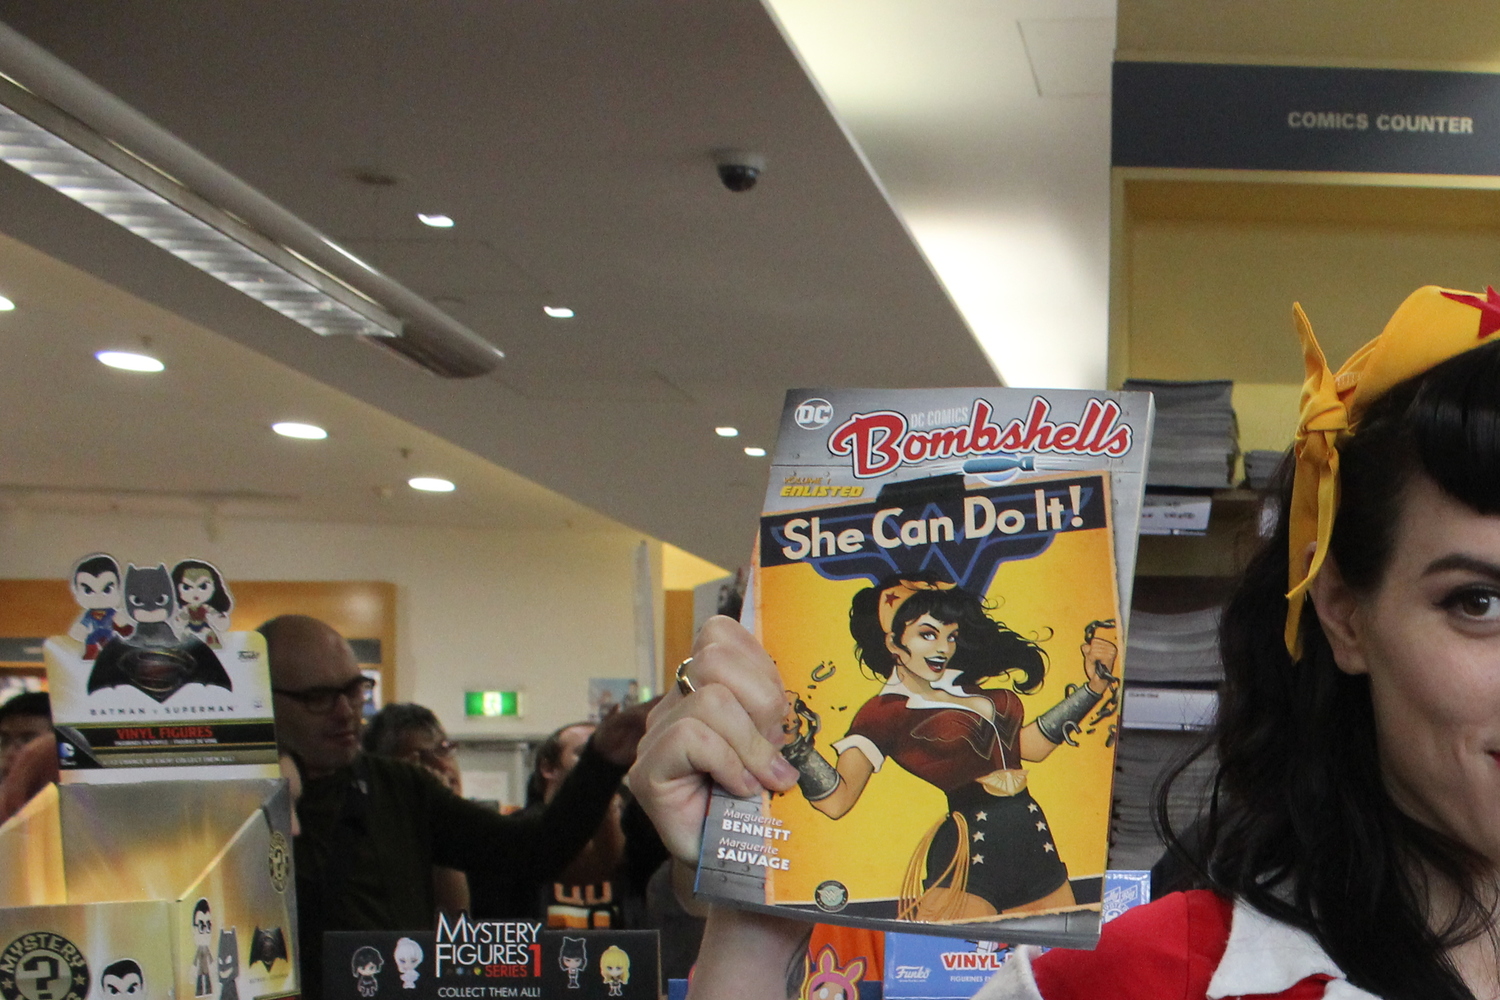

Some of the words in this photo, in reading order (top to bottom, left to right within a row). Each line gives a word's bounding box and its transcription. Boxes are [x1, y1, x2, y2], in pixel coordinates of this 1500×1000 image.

[1288, 111, 1368, 130] COMICS
[1377, 114, 1473, 134] COUNTER
[797, 402, 832, 425] DC
[911, 412, 925, 427] DC
[928, 406, 968, 425] COMICS
[828, 396, 1132, 478] Bombshells
[780, 486, 864, 498] ENLISTED
[782, 518, 864, 561] She
[872, 508, 954, 548] Can
[964, 496, 1025, 540] Do
[1036, 485, 1083, 531] It!
[90, 708, 145, 716] BATMAN
[164, 705, 235, 715] SUPERMAN
[116, 727, 154, 740] VINYL
[159, 725, 213, 738] FIGURES
[723, 808, 783, 827] Marguerite
[721, 819, 791, 842] BENNETT
[719, 836, 779, 856] Marguerite
[716, 847, 790, 870] SAUVAGE
[1, 932, 86, 974] MYSTERY
[485, 964, 528, 978] SERIES
[528, 944, 542, 978] 1
[941, 952, 1003, 970] VINYL
[895, 966, 932, 980] Funko
[950, 975, 982, 983] FIGURINES
[438, 987, 485, 998] COLLECT
[488, 987, 518, 998] THEM
[520, 987, 541, 998] ALL!
